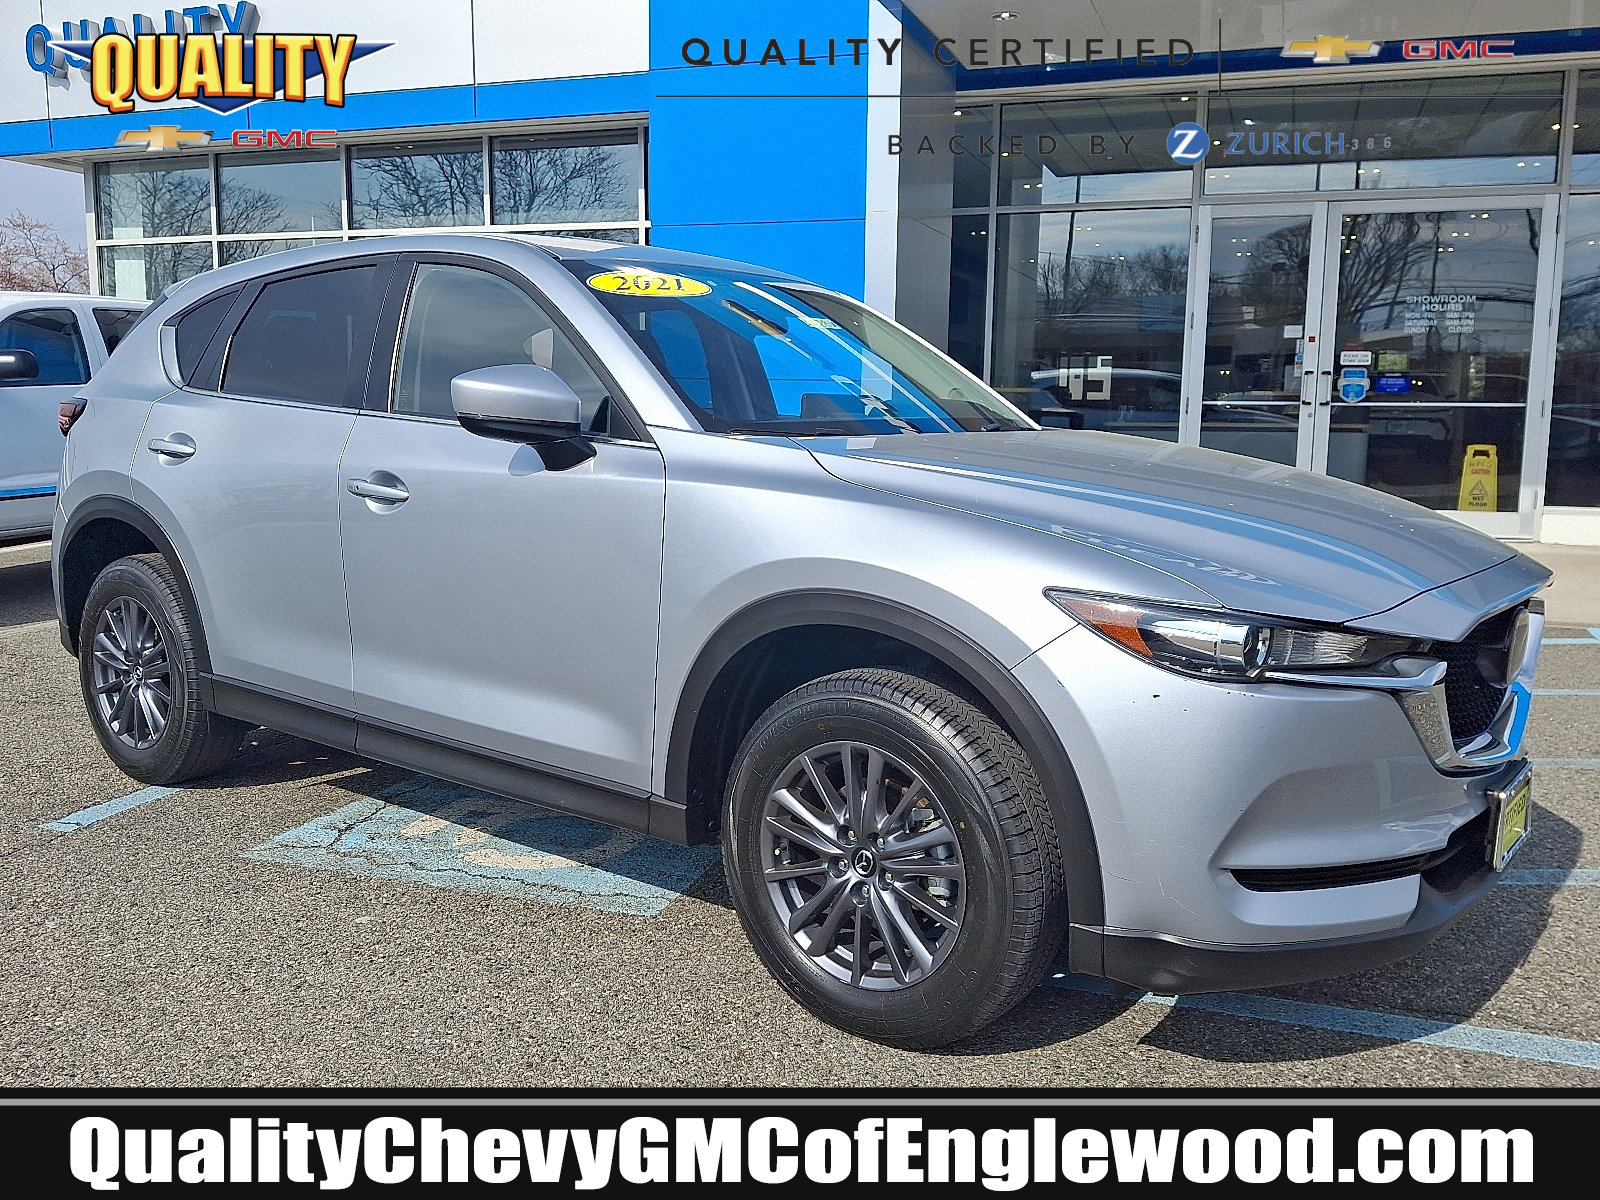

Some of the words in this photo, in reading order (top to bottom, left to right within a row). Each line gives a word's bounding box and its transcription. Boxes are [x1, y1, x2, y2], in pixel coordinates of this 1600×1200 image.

[612, 275, 686, 292] 2021
[1405, 294, 1477, 304] SHOWROOM
[1422, 303, 1463, 312] HOURS
